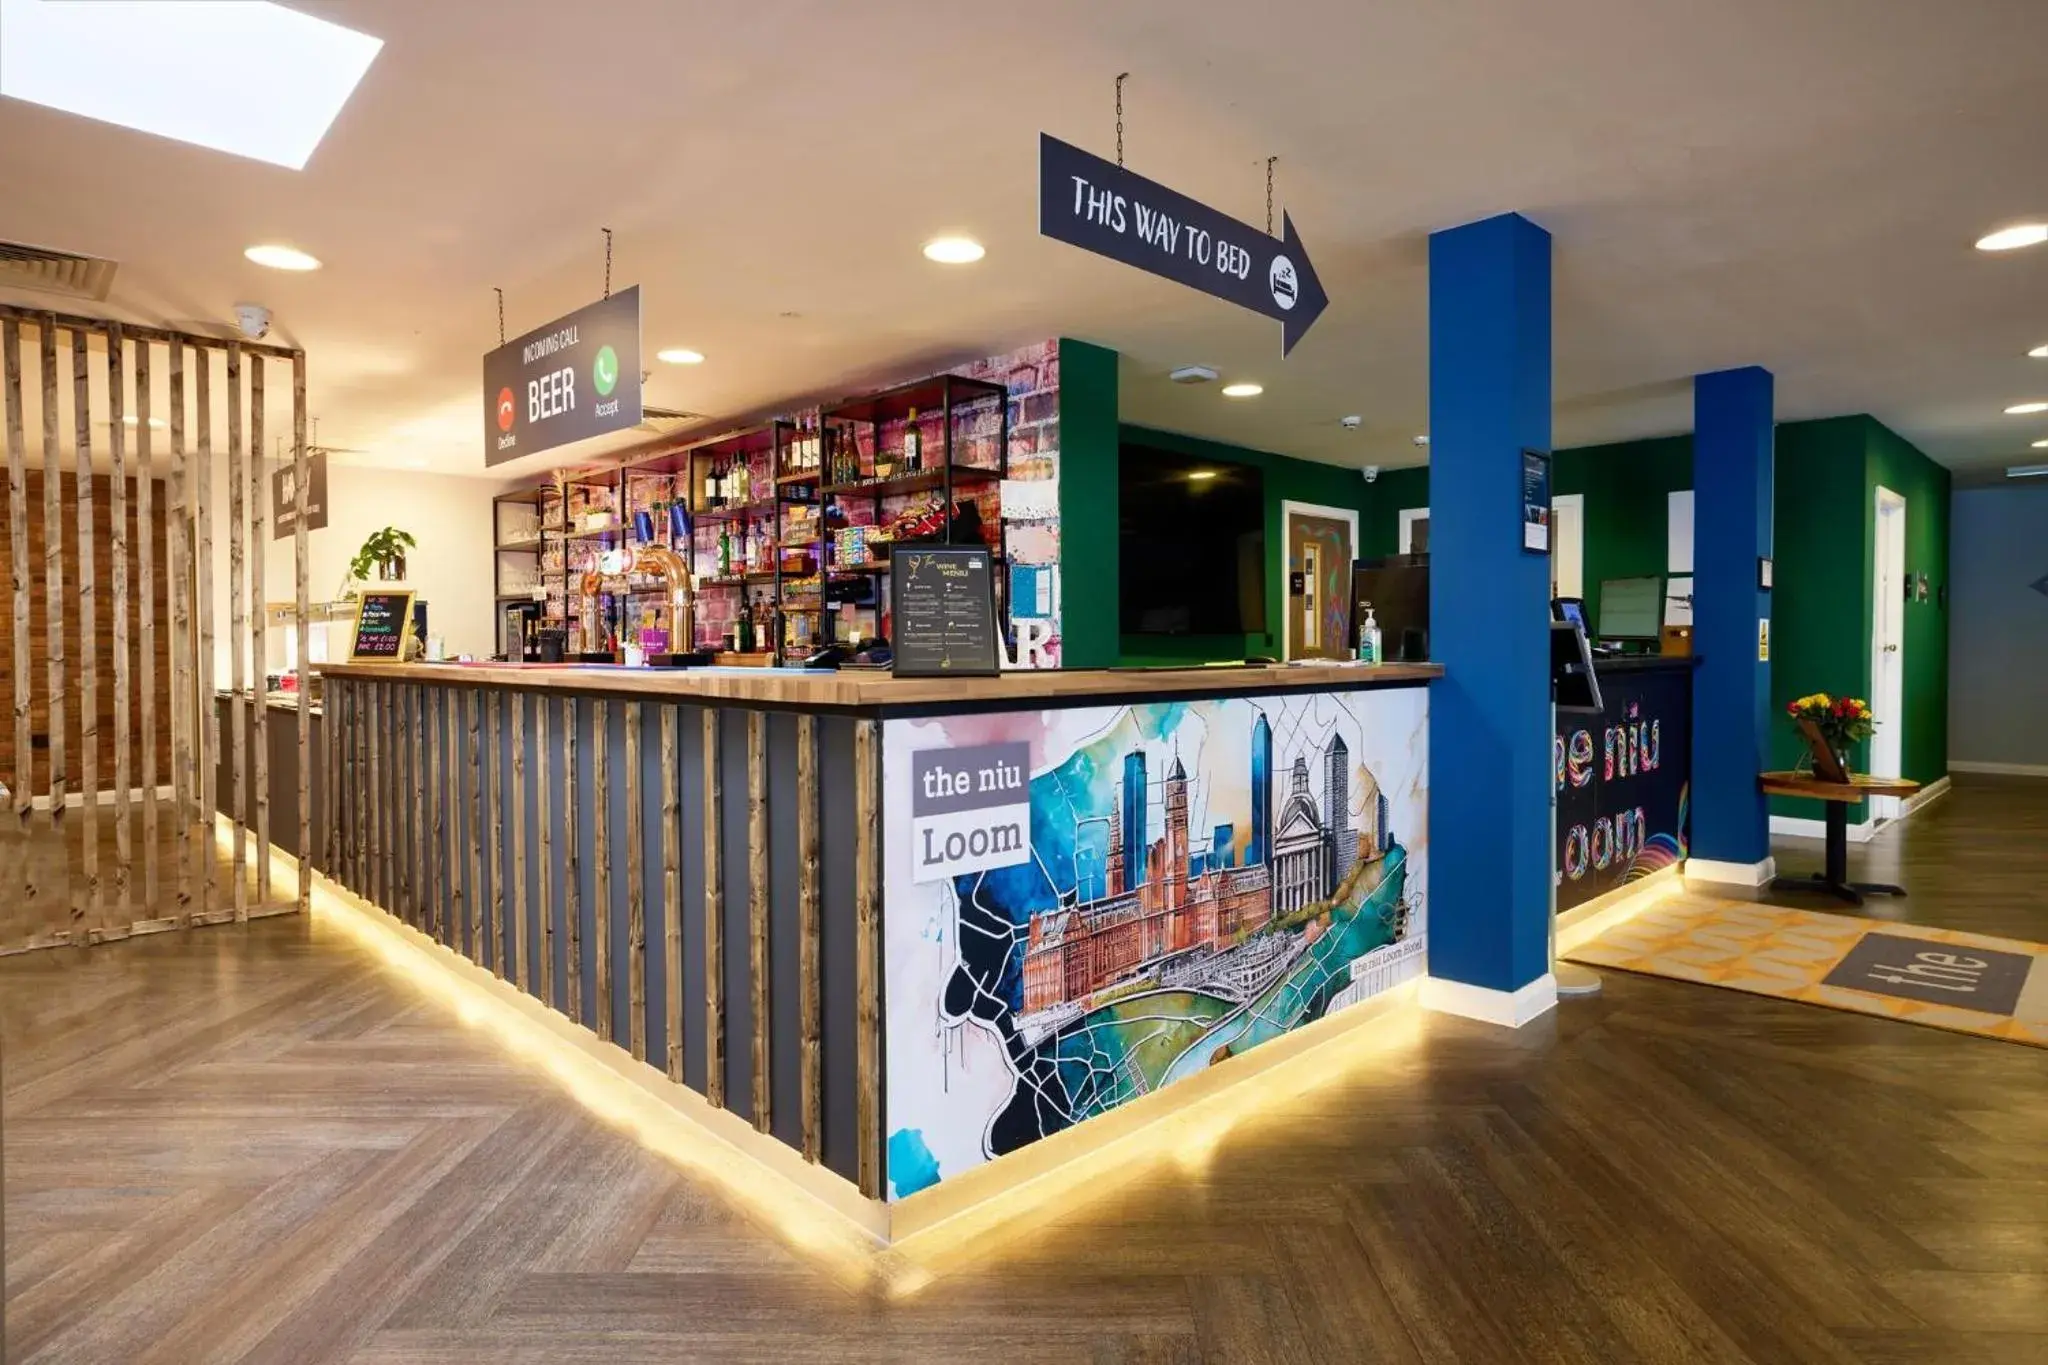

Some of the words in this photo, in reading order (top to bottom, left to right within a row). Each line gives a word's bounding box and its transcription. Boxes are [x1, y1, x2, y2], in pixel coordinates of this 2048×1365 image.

[1071, 175, 1126, 233] THIS
[1133, 201, 1181, 255] WAY
[1185, 224, 1211, 265] TO
[1216, 240, 1250, 280] BED
[523, 335, 560, 364] INCOMING
[560, 325, 580, 350] CALL
[528, 366, 576, 423] BEER
[595, 399, 619, 418] Accept
[497, 433, 517, 450] Decline
[1605, 702, 1659, 781] niu
[923, 766, 971, 798] the
[978, 760, 1022, 792] niu
[922, 822, 1023, 866] Loom
[1555, 806, 1645, 884] oom
[1383, 949, 1402, 963] Loom
[1403, 938, 1423, 955] Hotel
[1867, 952, 1988, 992] the
